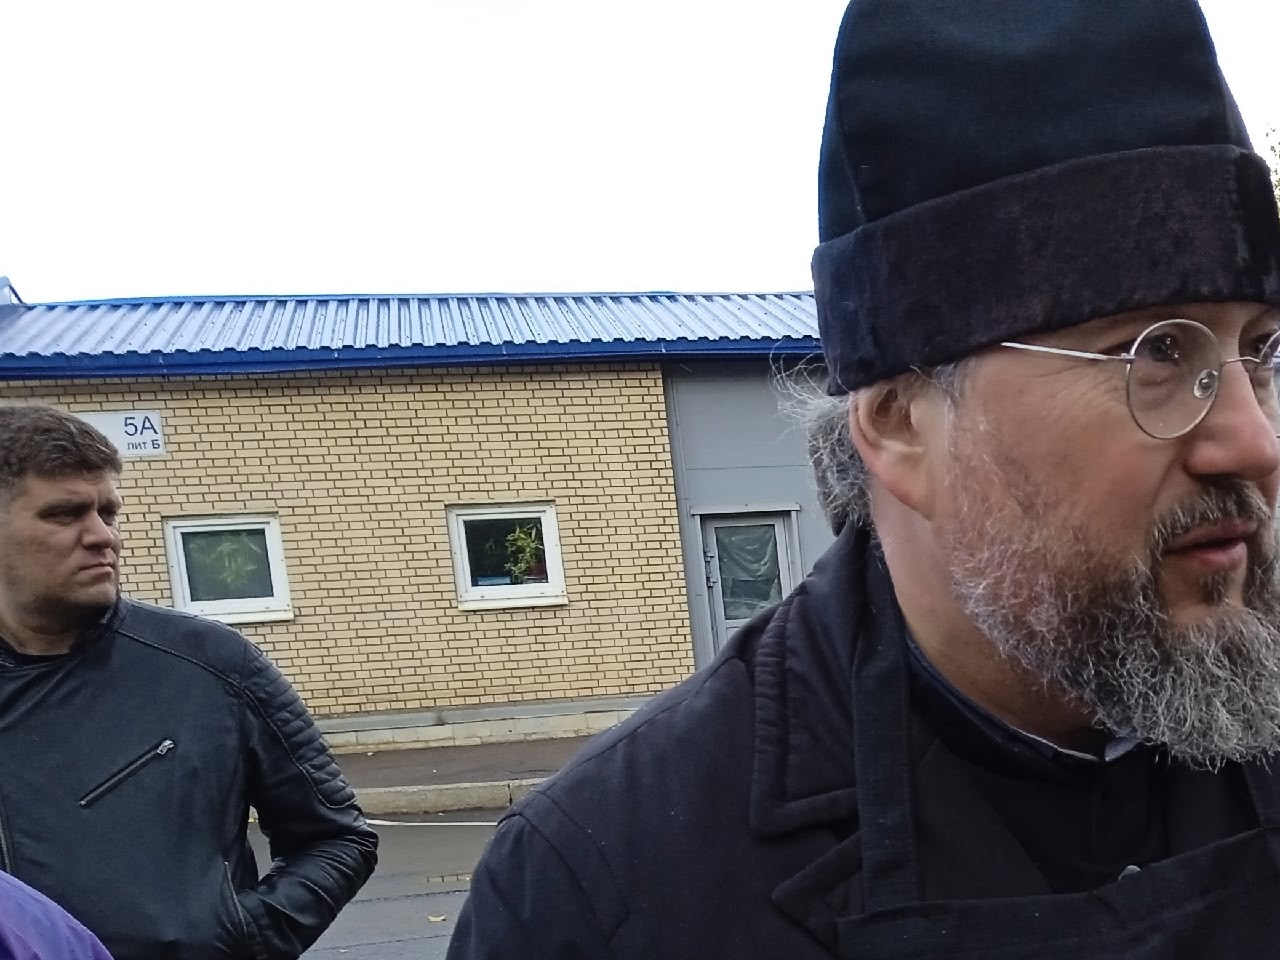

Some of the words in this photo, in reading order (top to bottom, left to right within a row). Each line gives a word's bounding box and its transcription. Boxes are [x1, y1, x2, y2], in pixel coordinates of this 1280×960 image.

[124, 416, 158, 436] 5А
[127, 441, 147, 450] лит
[151, 439, 160, 449] Б
